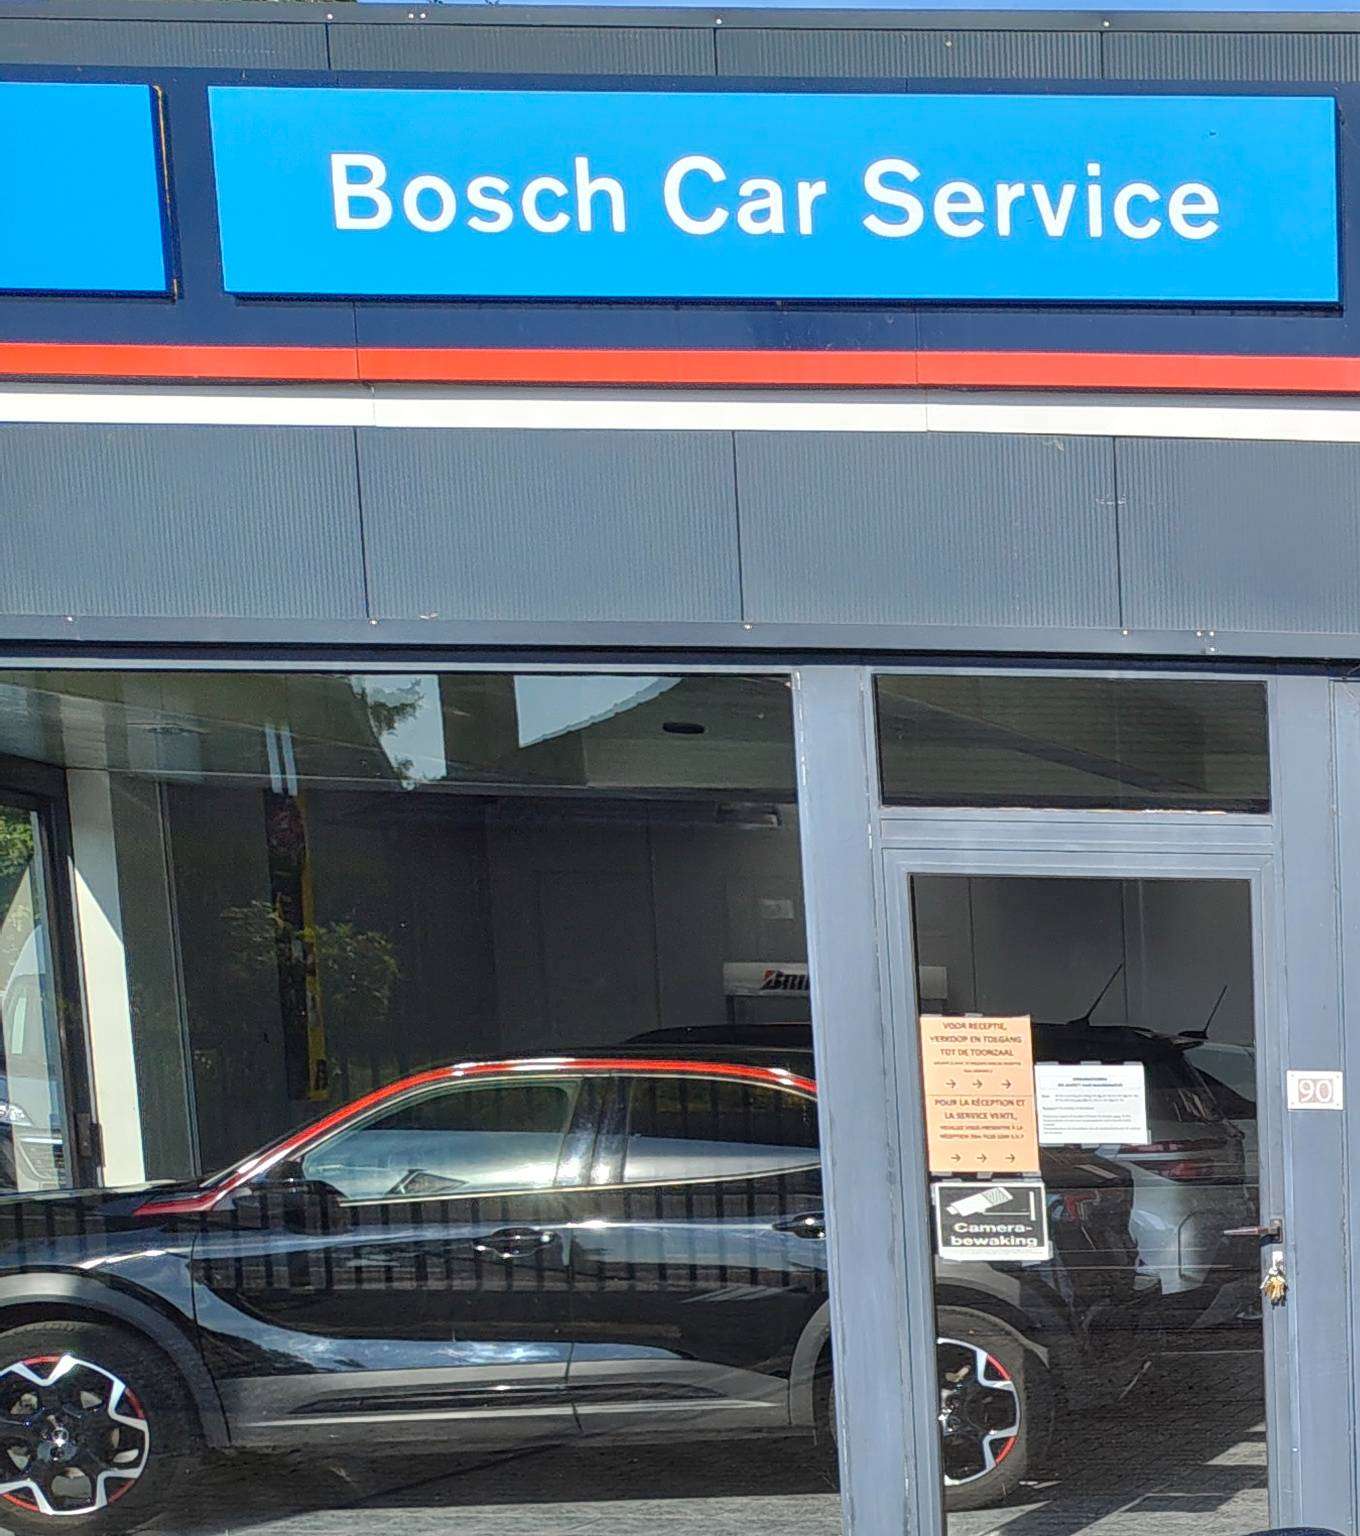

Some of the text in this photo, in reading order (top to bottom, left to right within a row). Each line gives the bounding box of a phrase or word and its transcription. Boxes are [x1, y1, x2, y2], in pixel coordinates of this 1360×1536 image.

[330, 153, 1220, 240] Bosch Car Service
[942, 1022, 968, 1031] VOOR
[930, 1035, 1023, 1045] VERKOOP EN TOEGANG
[940, 1048, 957, 1057] TOT
[958, 1048, 969, 1057] DE
[1298, 1078, 1334, 1104] 90
[934, 1098, 957, 1107] POUR
[959, 1098, 970, 1107] LA
[971, 1096, 1015, 1107] RÉCEPTION
[944, 1112, 955, 1120] LA
[956, 1112, 989, 1120] SERVICE
[953, 1222, 1032, 1234] Camera-
[950, 1235, 1039, 1249] bewaking
